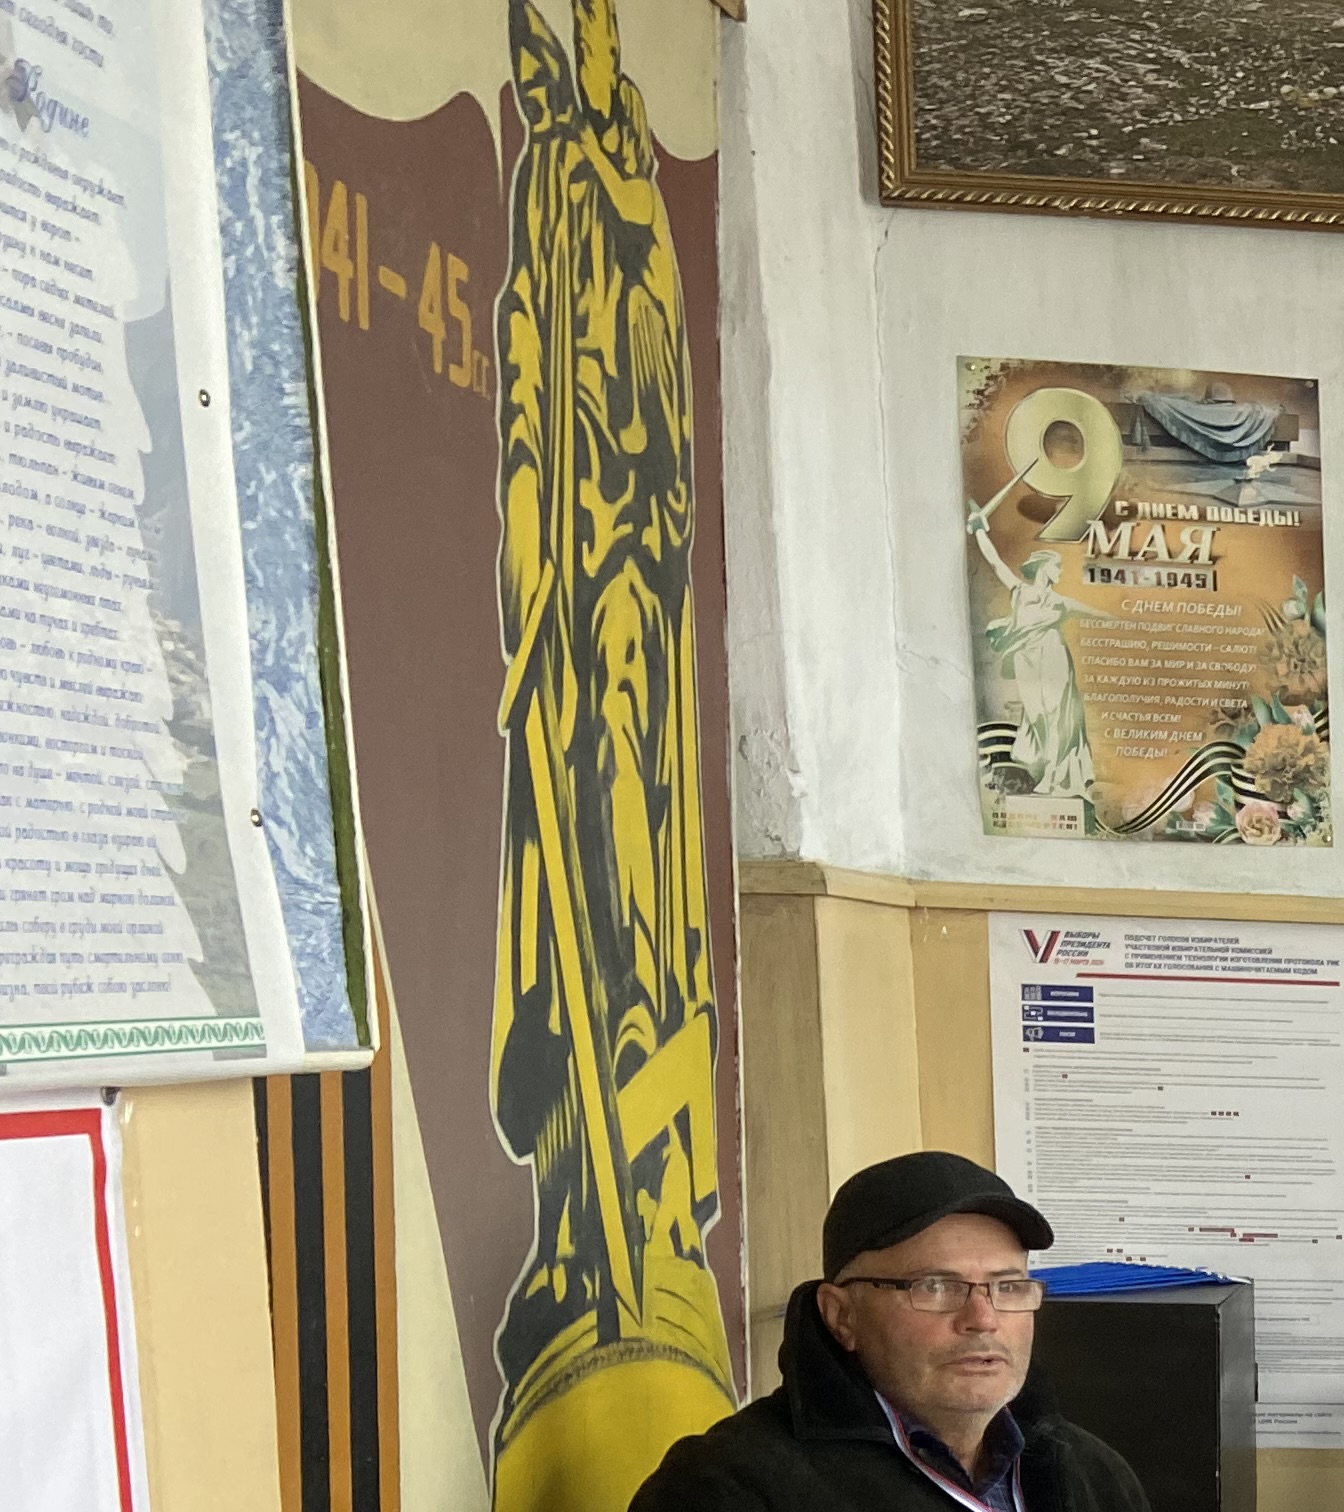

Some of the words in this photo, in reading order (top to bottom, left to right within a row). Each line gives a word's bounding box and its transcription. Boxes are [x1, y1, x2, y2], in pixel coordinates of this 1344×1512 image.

[1006, 388, 1122, 542] 9
[1115, 501, 1129, 516] С
[1137, 502, 1198, 521] ДНЕМ
[1206, 506, 1299, 527] ПОБЕДЫ!
[1085, 520, 1218, 565] МАЯ
[1122, 600, 1129, 611] С
[1132, 600, 1174, 614] ДНЕМ
[1177, 602, 1242, 618] ПОБЕДЫ!
[1128, 658, 1149, 667] ВАМ
[1150, 659, 1162, 668] ЗА
[1164, 660, 1185, 669] МИР
[1084, 674, 1096, 683] ЗА
[1097, 675, 1141, 687] КАЖДУЮ
[1165, 696, 1209, 707] РАДОСТИ
[1219, 698, 1248, 709] СВЕТА
[1113, 729, 1168, 740] ВЕЛИКИМ
[1170, 731, 1203, 742] ДНЕМ
[1116, 747, 1168, 760] ПОБЕДЫ!
